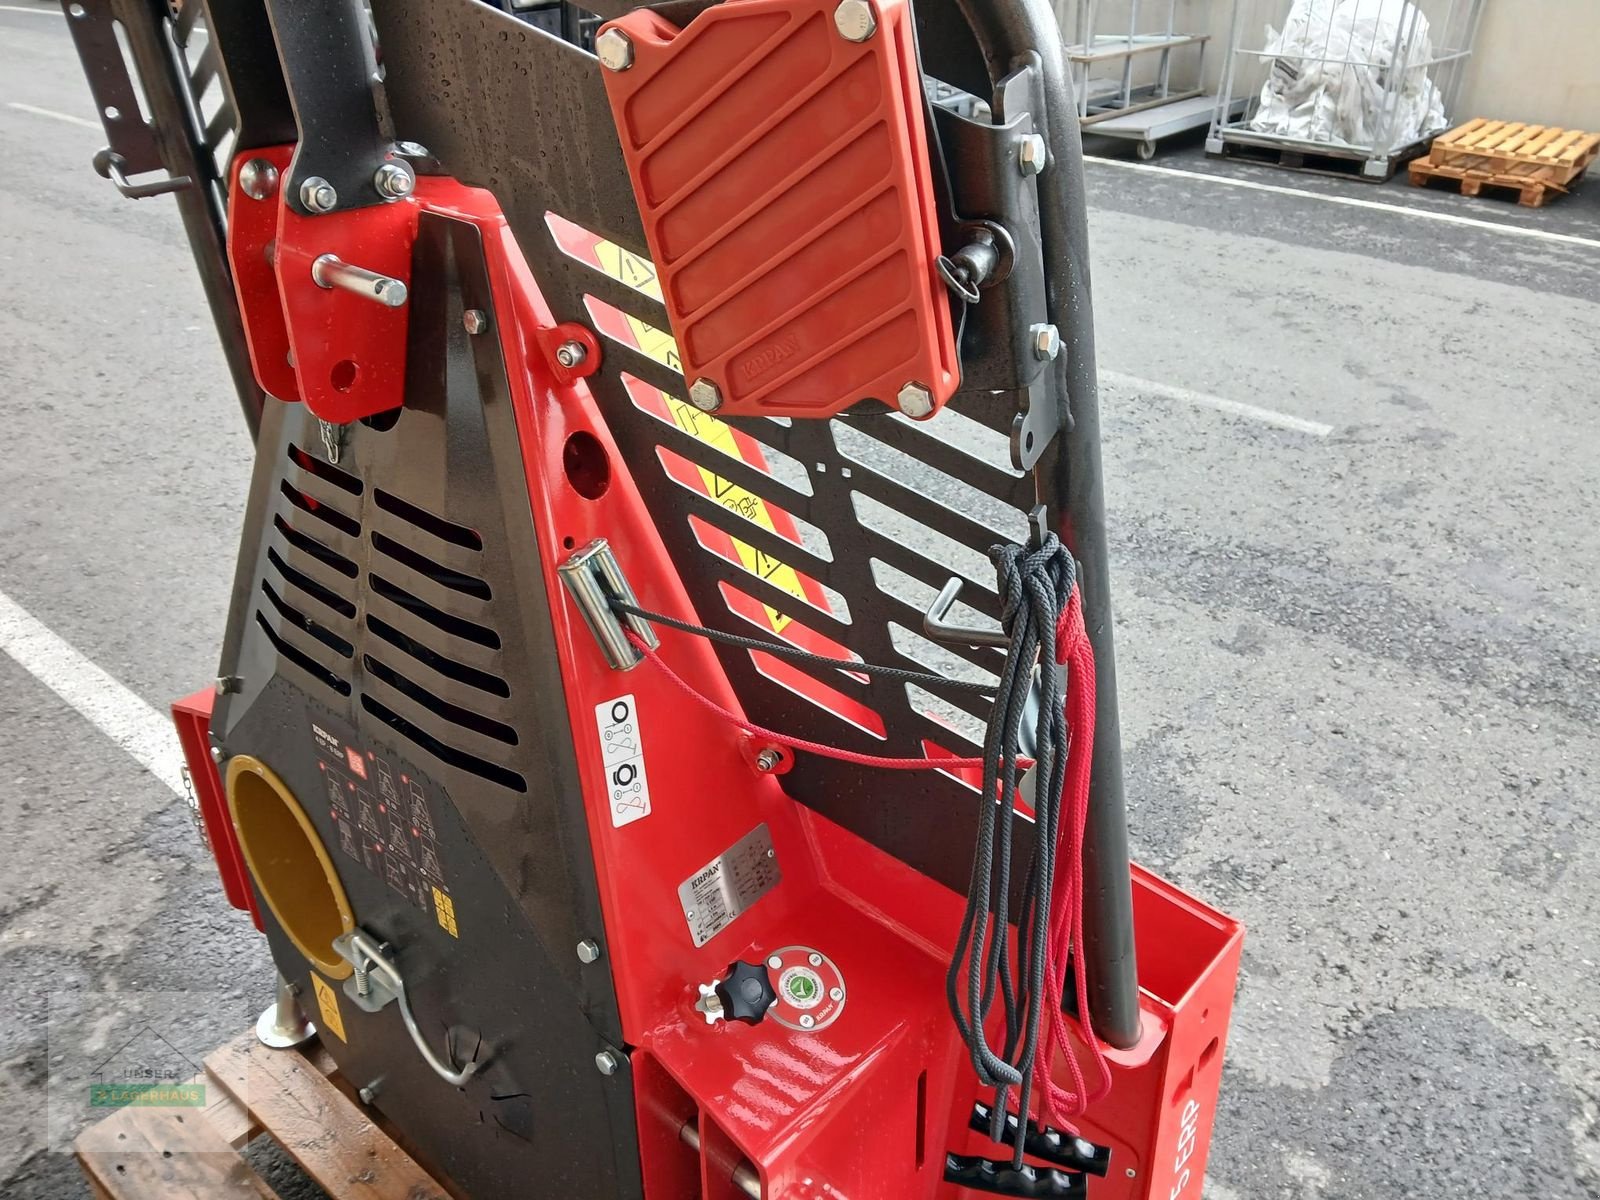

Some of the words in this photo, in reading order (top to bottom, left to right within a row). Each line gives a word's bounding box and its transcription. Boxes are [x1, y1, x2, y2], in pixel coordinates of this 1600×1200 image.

[743, 333, 800, 382] KRPAN
[691, 865, 720, 889] KRPAN
[1174, 1099, 1200, 1174] ERP
